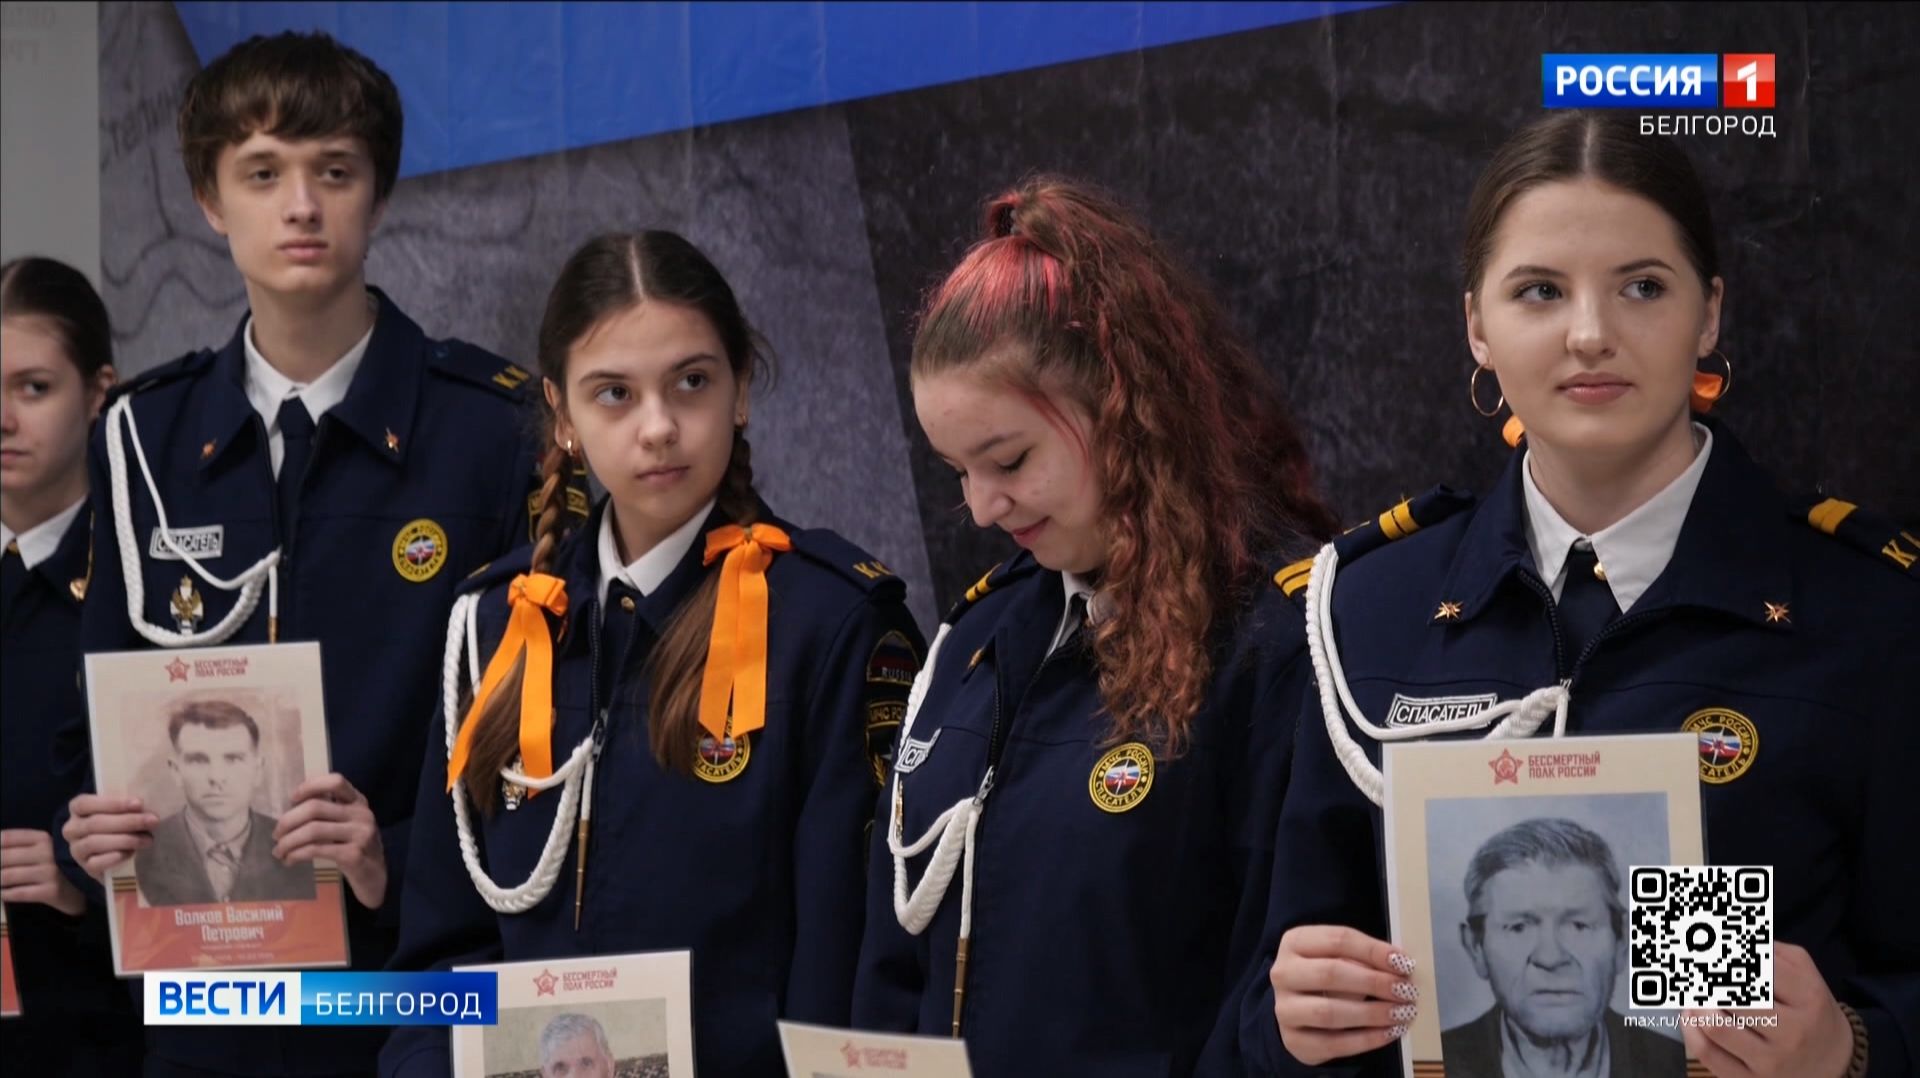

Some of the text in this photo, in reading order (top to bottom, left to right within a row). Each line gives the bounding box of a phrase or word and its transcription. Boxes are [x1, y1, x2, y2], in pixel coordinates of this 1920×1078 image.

[1528, 751, 1601, 767] БЕССМЕРТНЫЙ
[1529, 766, 1596, 779] ПОЛК РОССИИ
[1096, 781, 1144, 805] СПАСАТЕЛЬ
[174, 905, 284, 926] Волков Василий
[201, 924, 264, 943] Петрович
